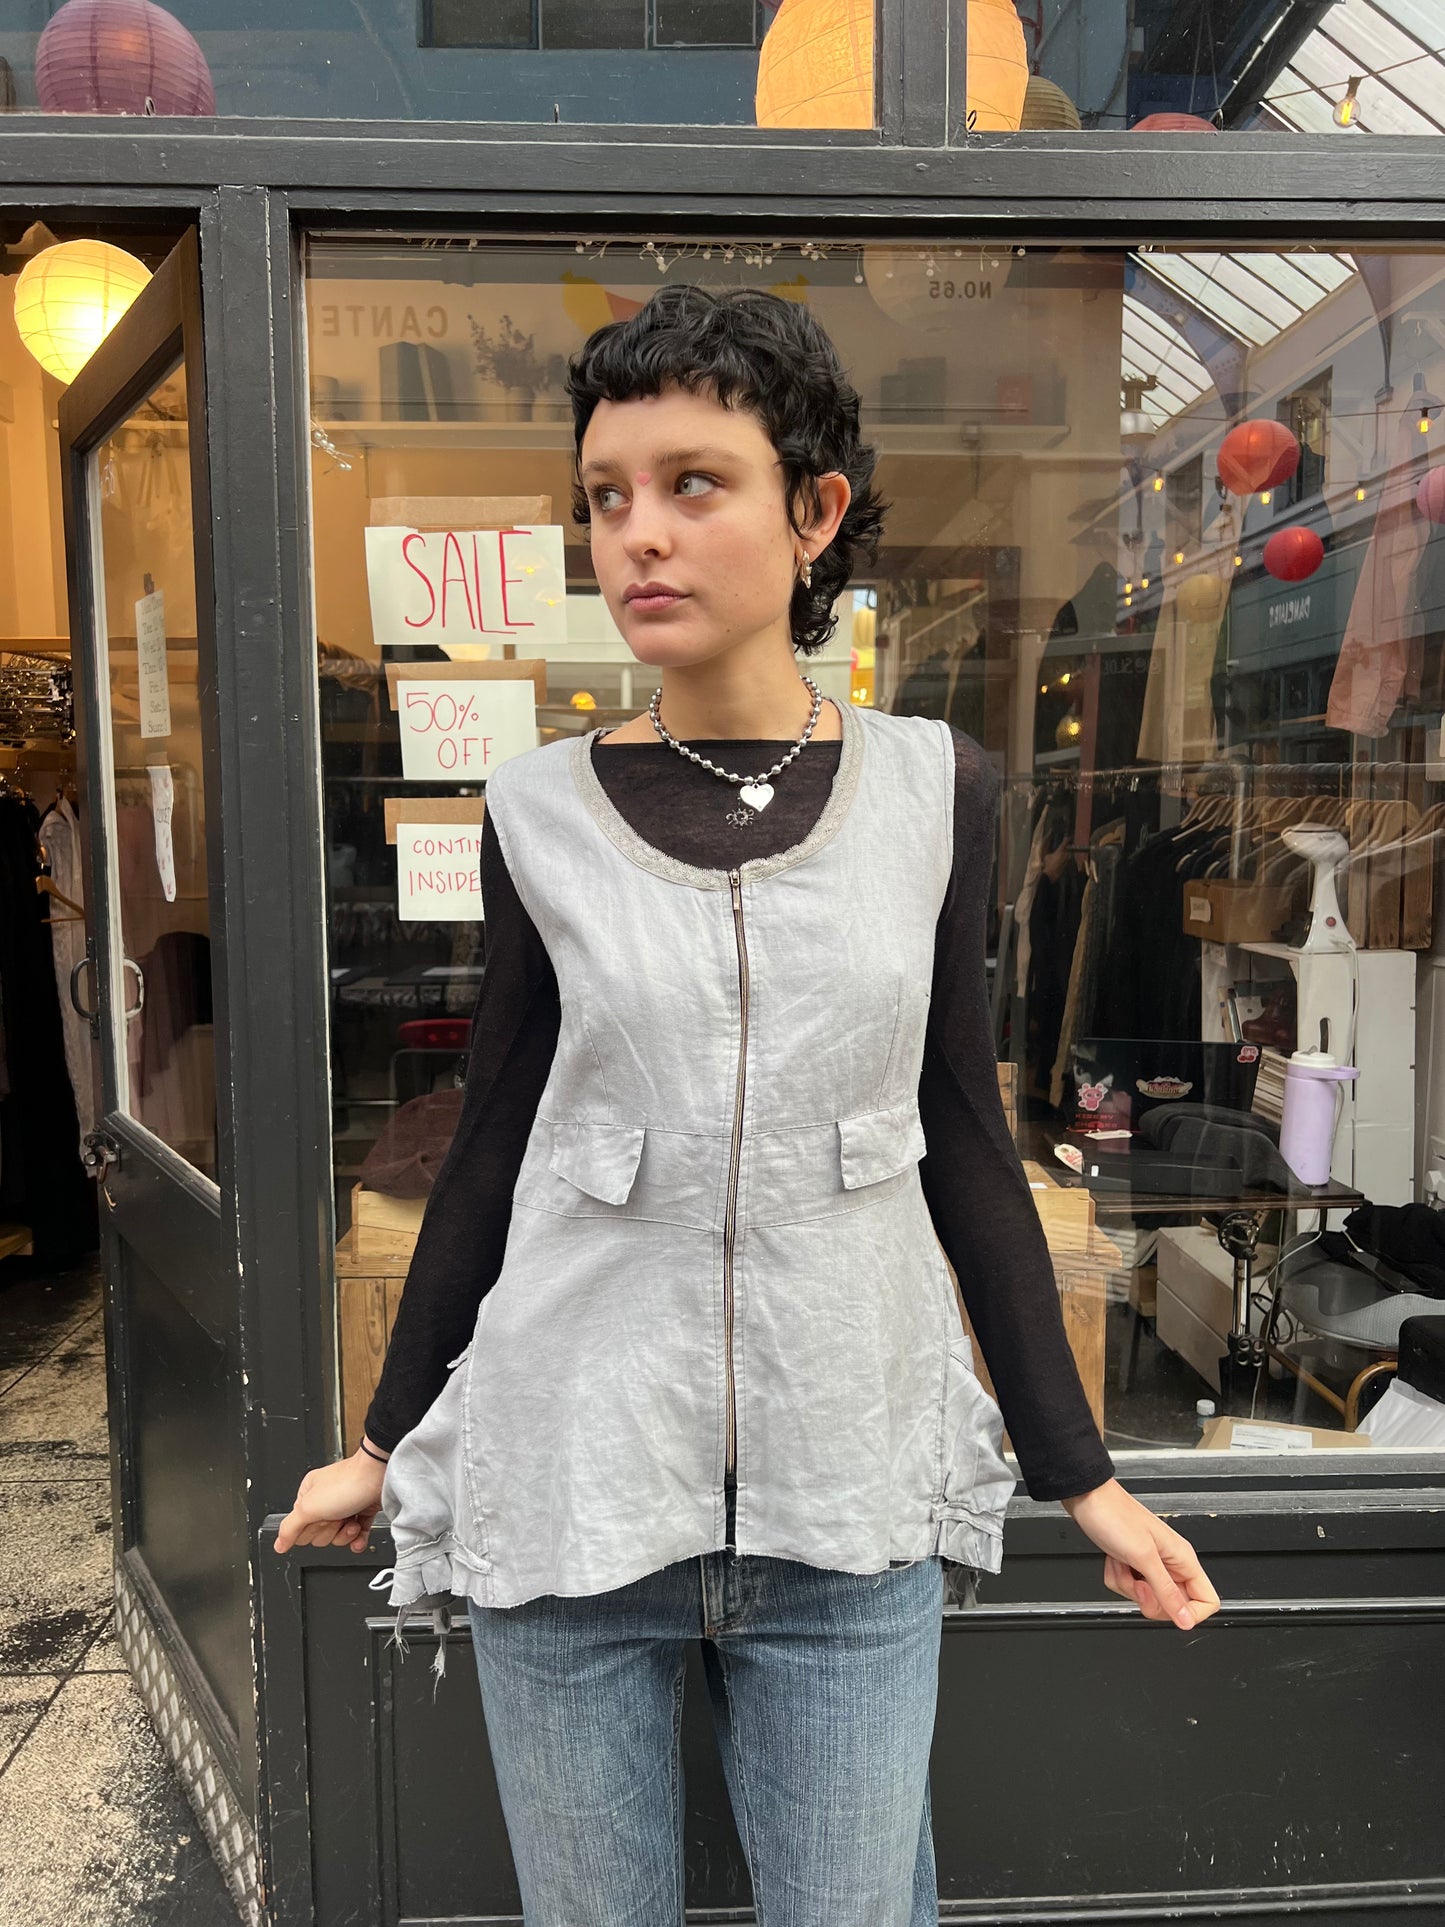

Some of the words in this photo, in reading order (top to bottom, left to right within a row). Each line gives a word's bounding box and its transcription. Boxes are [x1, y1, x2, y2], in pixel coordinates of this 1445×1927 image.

[402, 530, 536, 635] SALE
[406, 692, 480, 733] 50%
[437, 737, 494, 769] OFF
[409, 869, 481, 896] INSIDE
